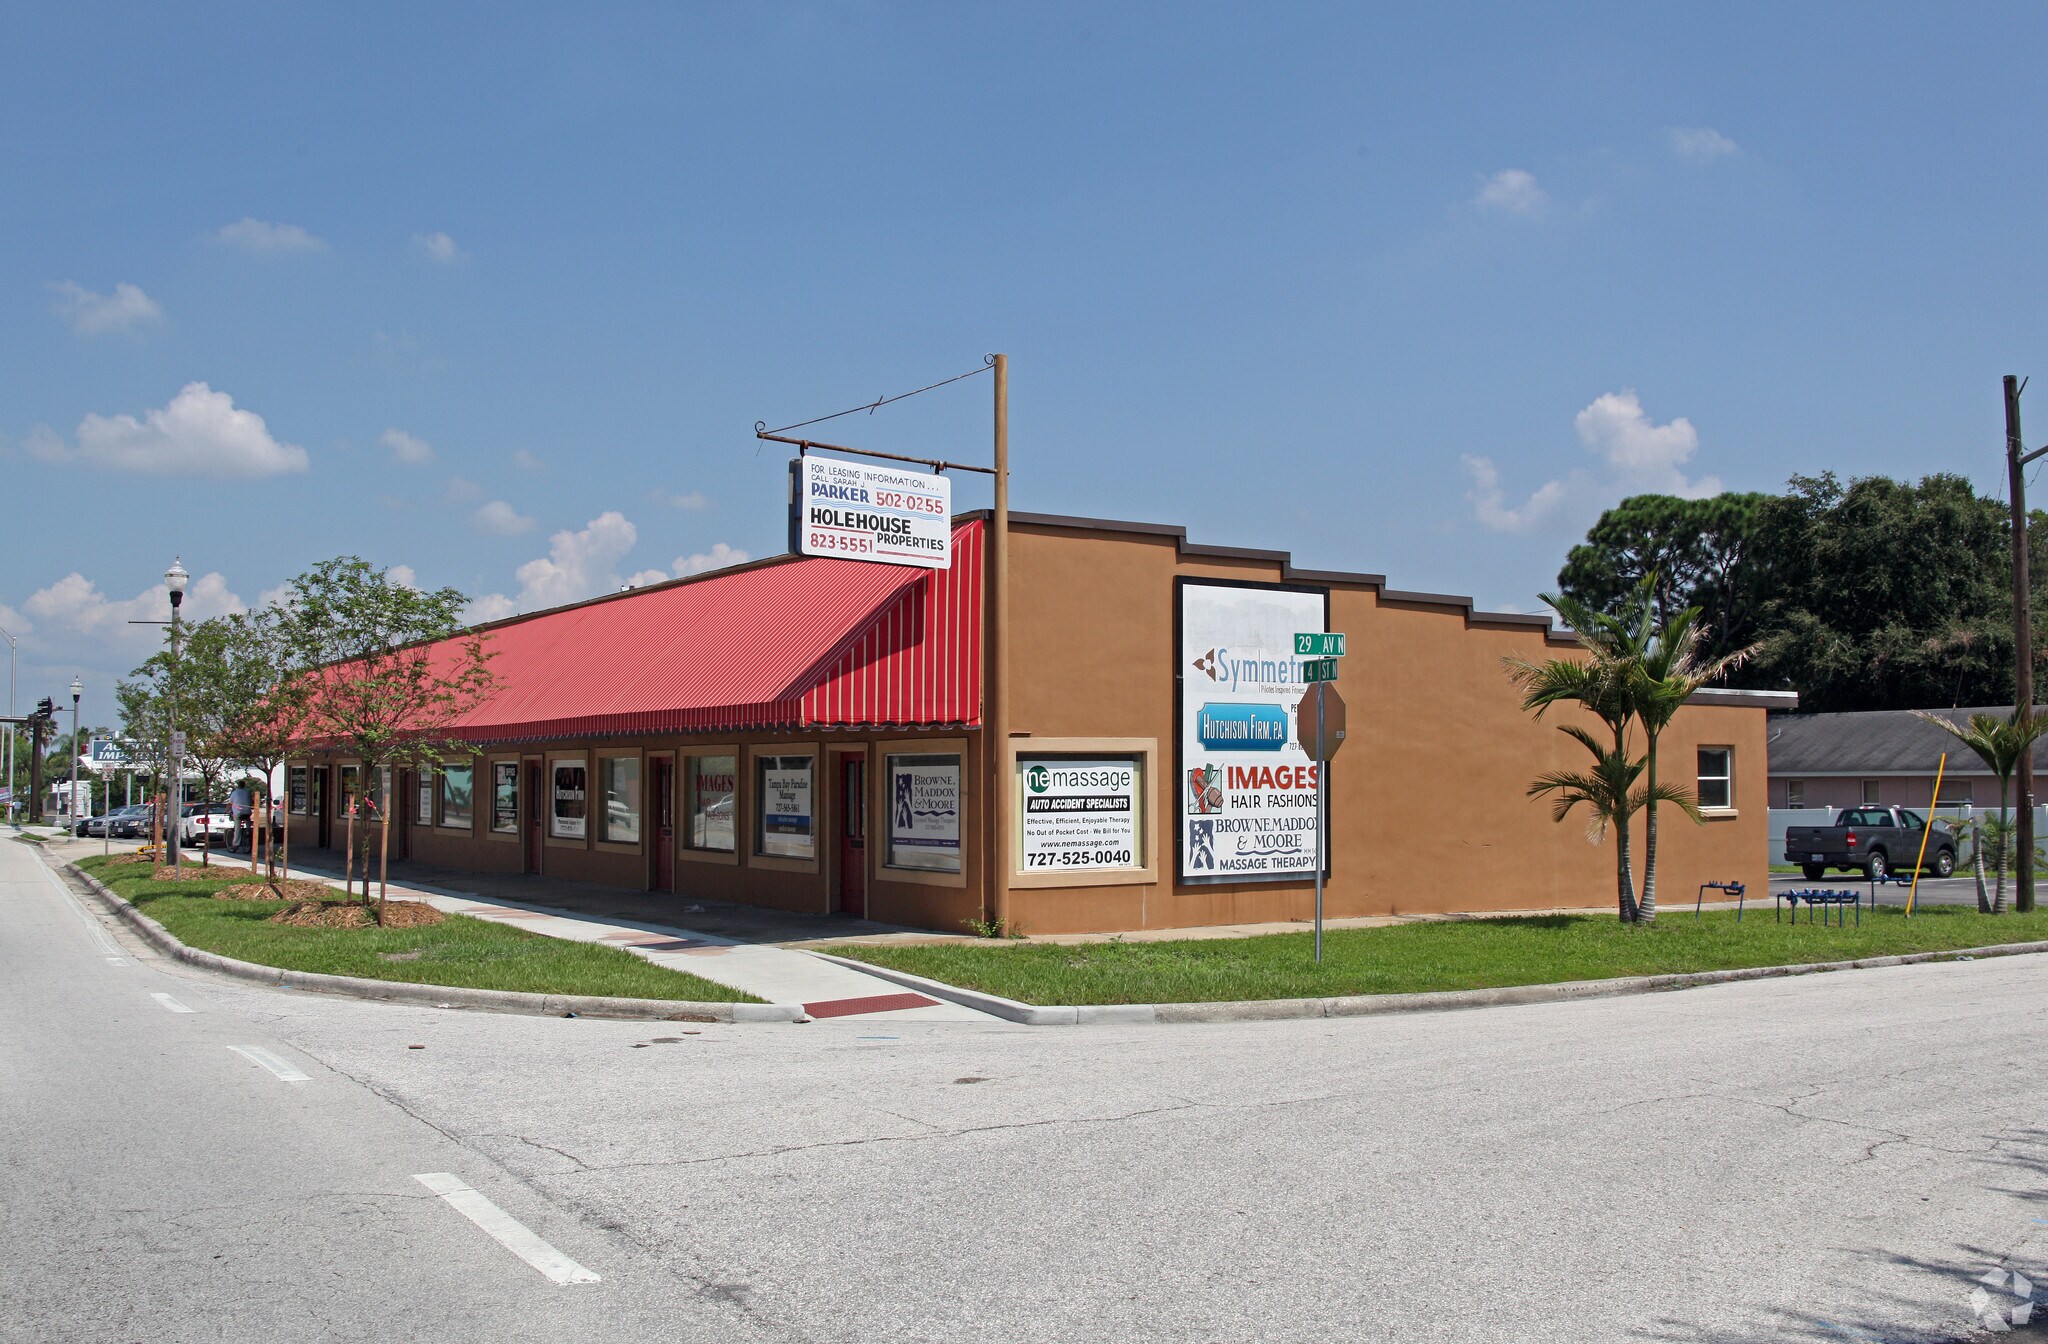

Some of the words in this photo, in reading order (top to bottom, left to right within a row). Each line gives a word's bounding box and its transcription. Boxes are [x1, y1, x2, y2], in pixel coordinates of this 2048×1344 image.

[812, 464, 824, 474] FOR
[829, 467, 860, 479] LEASING
[812, 474, 828, 482] CALL
[833, 477, 857, 486] SARAH
[812, 483, 870, 504] PARKER
[811, 508, 911, 534] HOLEHOUSE
[877, 533, 944, 551] PROPERTIES
[1298, 636, 1312, 652] 29
[1323, 636, 1334, 653] AV
[1338, 637, 1344, 653] N
[1218, 648, 1304, 692] Symmetr
[1308, 666, 1313, 680] 4
[1322, 662, 1330, 678] ST
[1333, 661, 1337, 677] N
[1275, 686, 1290, 695] Inspired
[1204, 714, 1248, 739] HUTCHISON
[696, 774, 733, 792] IMAGES
[769, 779, 781, 791] Tampa
[1053, 771, 1130, 791] massage
[1228, 766, 1316, 790] IMAGES
[914, 787, 955, 797] MADDOX
[1030, 799, 1050, 810] AUTO
[1051, 799, 1085, 809] ACCIDENT
[1086, 798, 1128, 809] SPECIALISTS
[1232, 795, 1261, 808] HAIR
[1268, 794, 1317, 808] FASHIONS
[1041, 839, 1119, 848] www.nemassage.com
[1237, 836, 1248, 850] &
[1254, 834, 1302, 848] MOORE
[1028, 850, 1130, 866] 727-525-0040
[1220, 858, 1267, 870] MASSAGE
[1272, 856, 1317, 868] THERAPY
